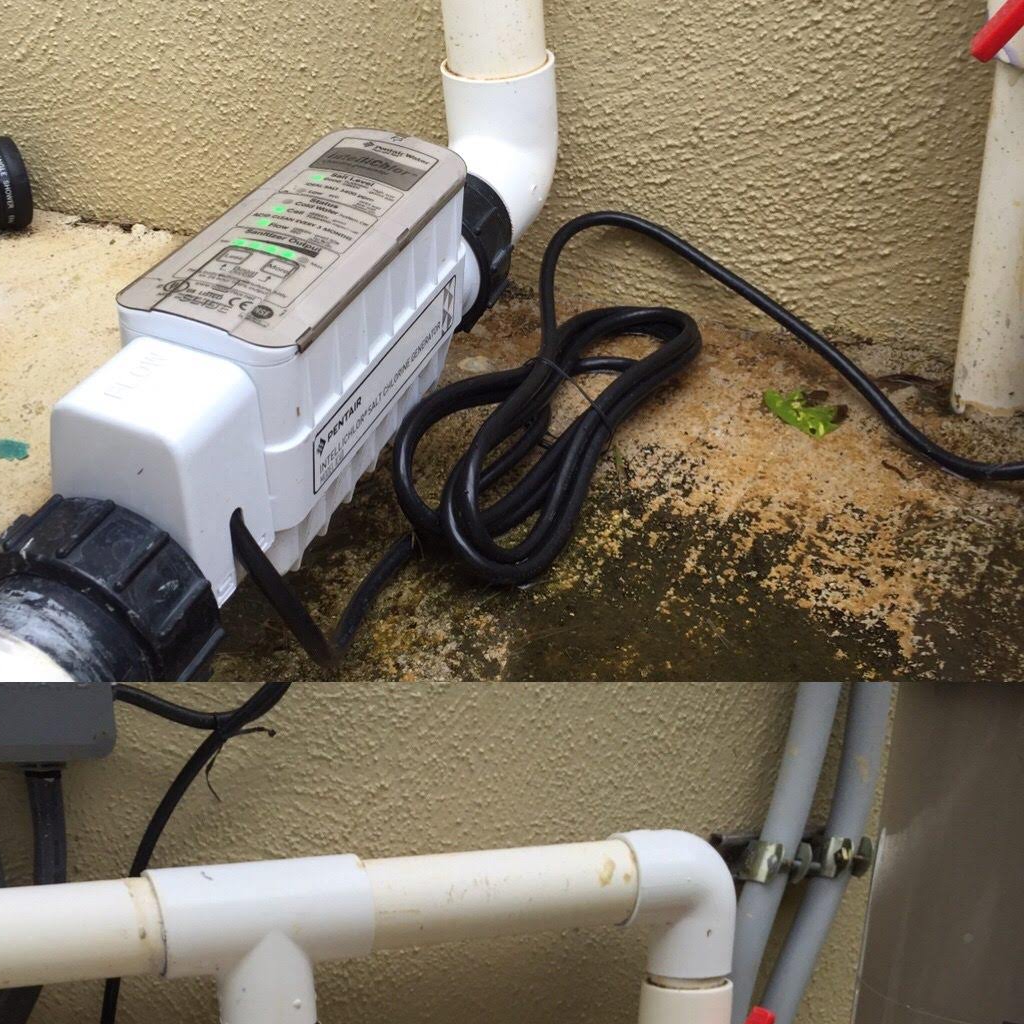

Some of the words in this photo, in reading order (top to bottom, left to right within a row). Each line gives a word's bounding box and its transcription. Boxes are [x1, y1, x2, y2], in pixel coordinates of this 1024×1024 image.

[2, 180, 15, 209] SHOWER
[310, 198, 339, 209] Status
[245, 228, 288, 241] Sanitizer
[288, 237, 323, 253] Output
[327, 396, 362, 443] PENTAIR
